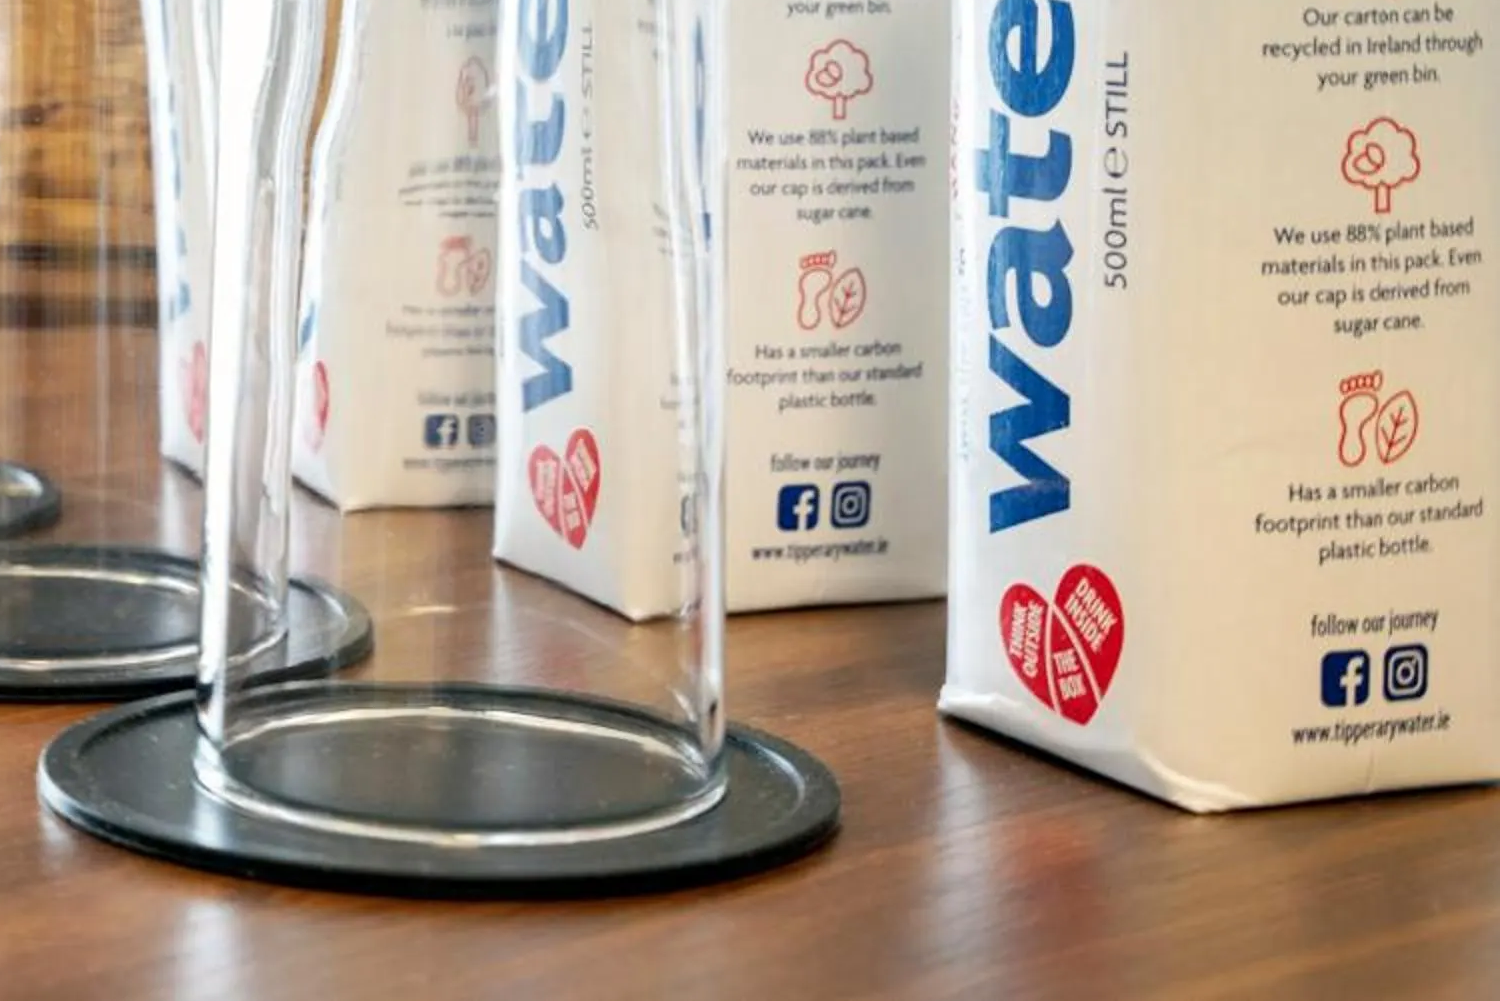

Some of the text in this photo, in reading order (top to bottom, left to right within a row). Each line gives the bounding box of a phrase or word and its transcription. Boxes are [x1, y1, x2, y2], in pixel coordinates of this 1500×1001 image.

[787, 1, 820, 18] your
[825, 0, 864, 19] green
[1303, 1, 1454, 27] Our carton can be
[1262, 31, 1483, 61] recycled in Ireland through
[1317, 64, 1440, 91] your green bin.
[1105, 51, 1129, 138] STILL
[748, 131, 775, 145] We
[779, 133, 804, 144] use
[842, 128, 877, 148] plant
[881, 126, 920, 143] based
[736, 156, 807, 170] materials
[812, 155, 825, 168] in
[749, 176, 915, 199] our cap is derived from
[796, 206, 835, 224] sugar
[1104, 188, 1129, 289] 500ml
[1273, 216, 1474, 246] We use 88% plant based
[1261, 248, 1482, 275] materials in this pack. Even
[1277, 278, 1471, 308] our cap is derived from
[1334, 313, 1424, 338] sugar cane.
[755, 340, 901, 359] Has a smaller carbon
[726, 362, 923, 389] footprint than our standard
[778, 395, 826, 414] plastic
[771, 453, 810, 473] follow
[1288, 473, 1459, 502] Has a smaller carbon
[1254, 498, 1483, 537] footprint than our standard
[1318, 535, 1433, 566] plastic bottle.
[1075, 577, 1118, 631] DRINK
[1009, 600, 1028, 659] THINK
[1064, 593, 1105, 654] INSIDE
[1310, 609, 1438, 637] follow our journey
[1022, 599, 1044, 677] OUTSIDE
[1053, 648, 1081, 674] THE
[1057, 673, 1087, 701] BOX
[1292, 711, 1450, 745] www.tipperarywater.ie
